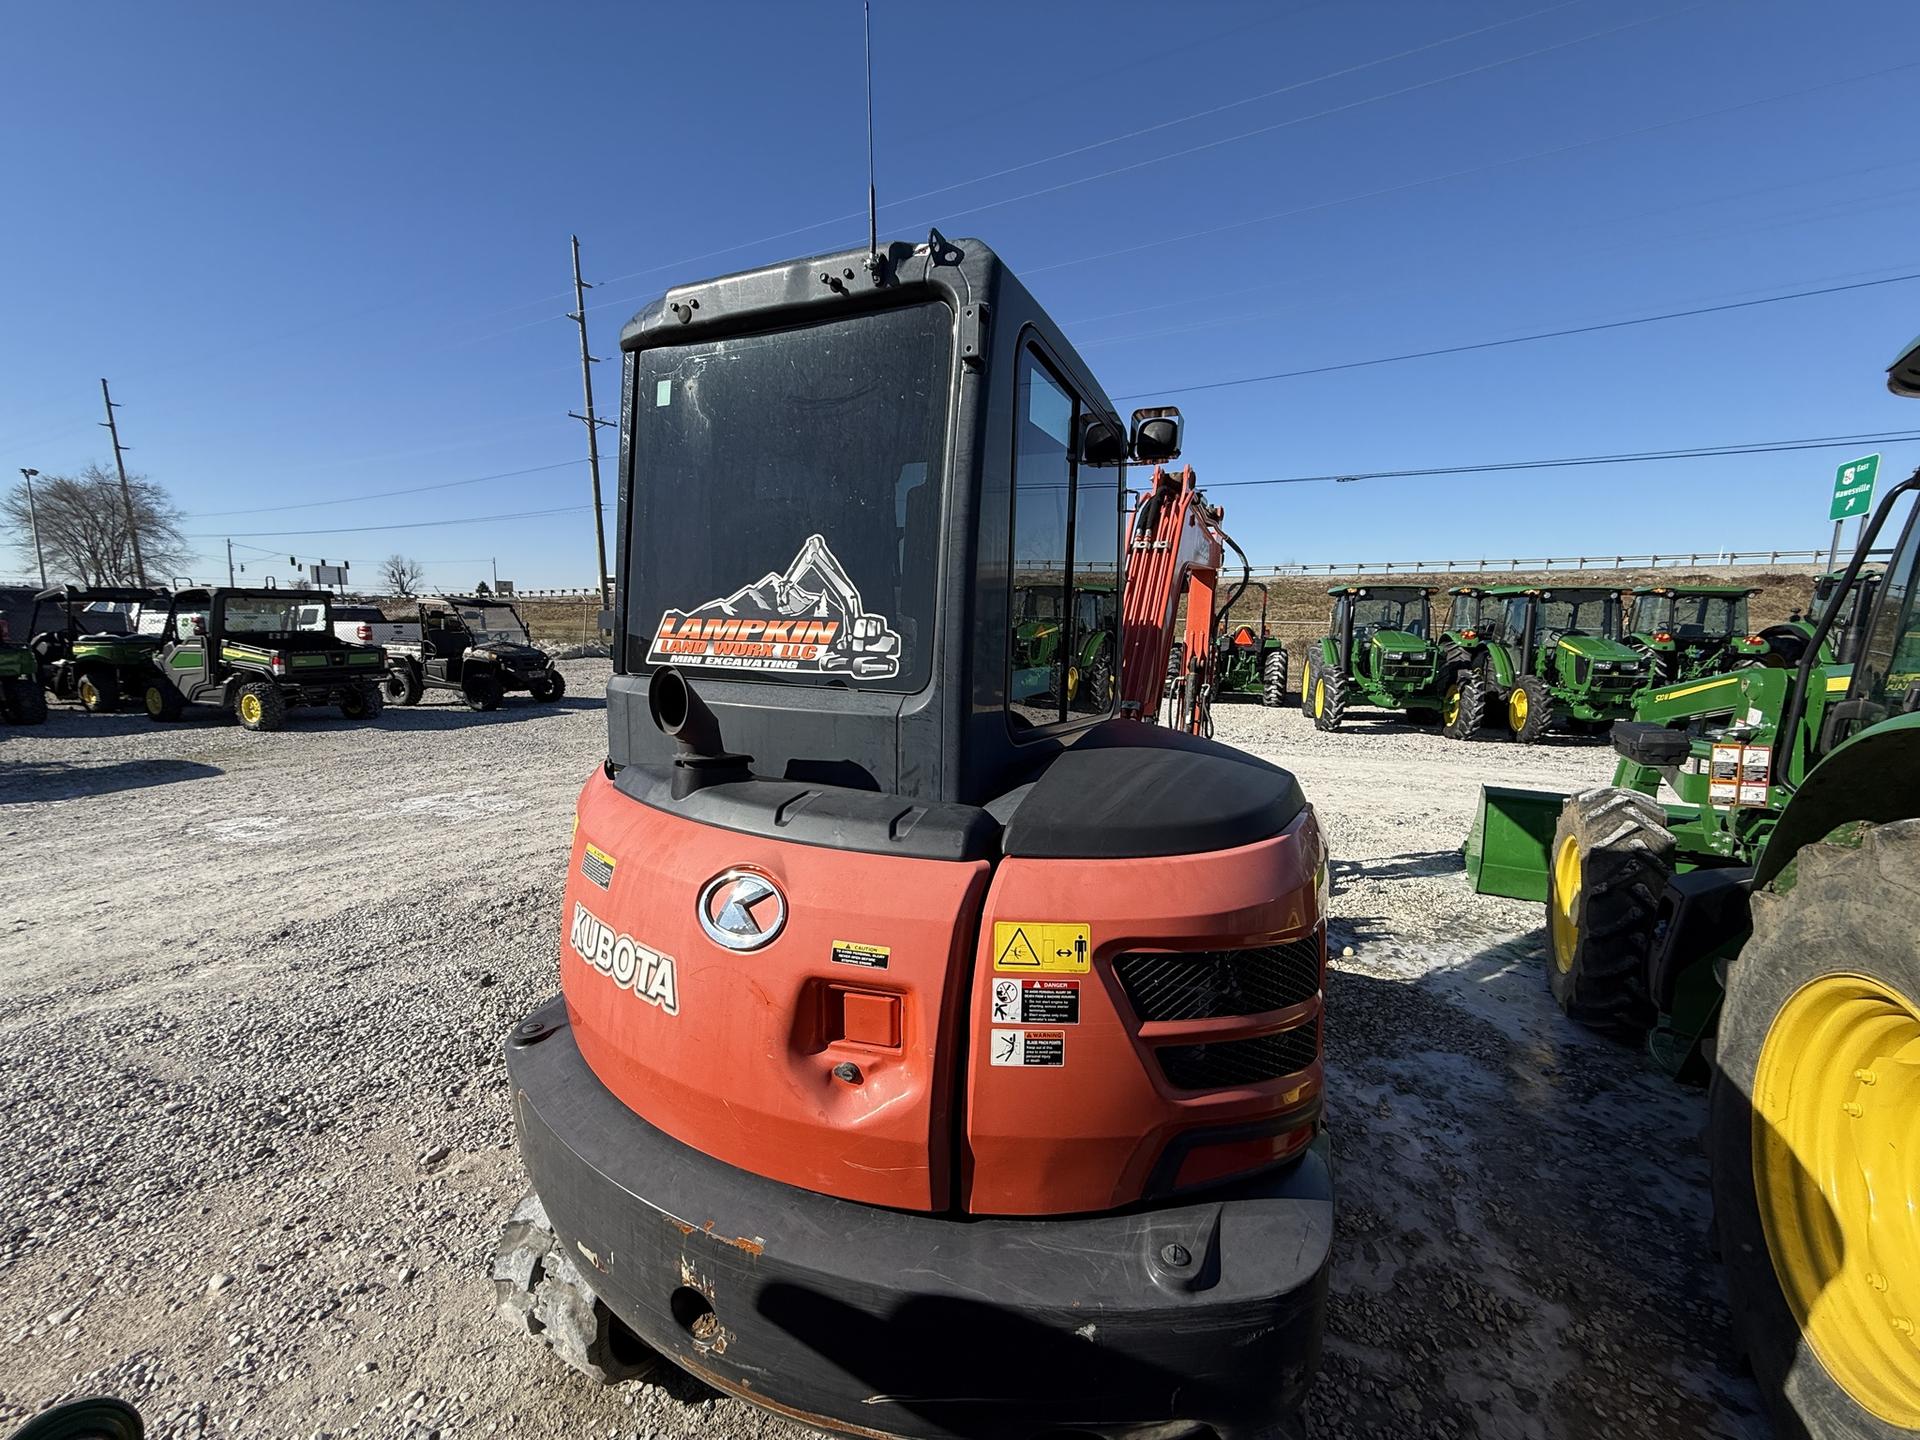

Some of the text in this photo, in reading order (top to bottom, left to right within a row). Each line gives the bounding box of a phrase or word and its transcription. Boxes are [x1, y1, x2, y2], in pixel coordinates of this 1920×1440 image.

[659, 618, 839, 644] LAMPKIN
[660, 640, 818, 660] LAND WURX LLC
[670, 655, 799, 669] MINI EXCAVATING
[571, 902, 677, 1011] KUBOTA
